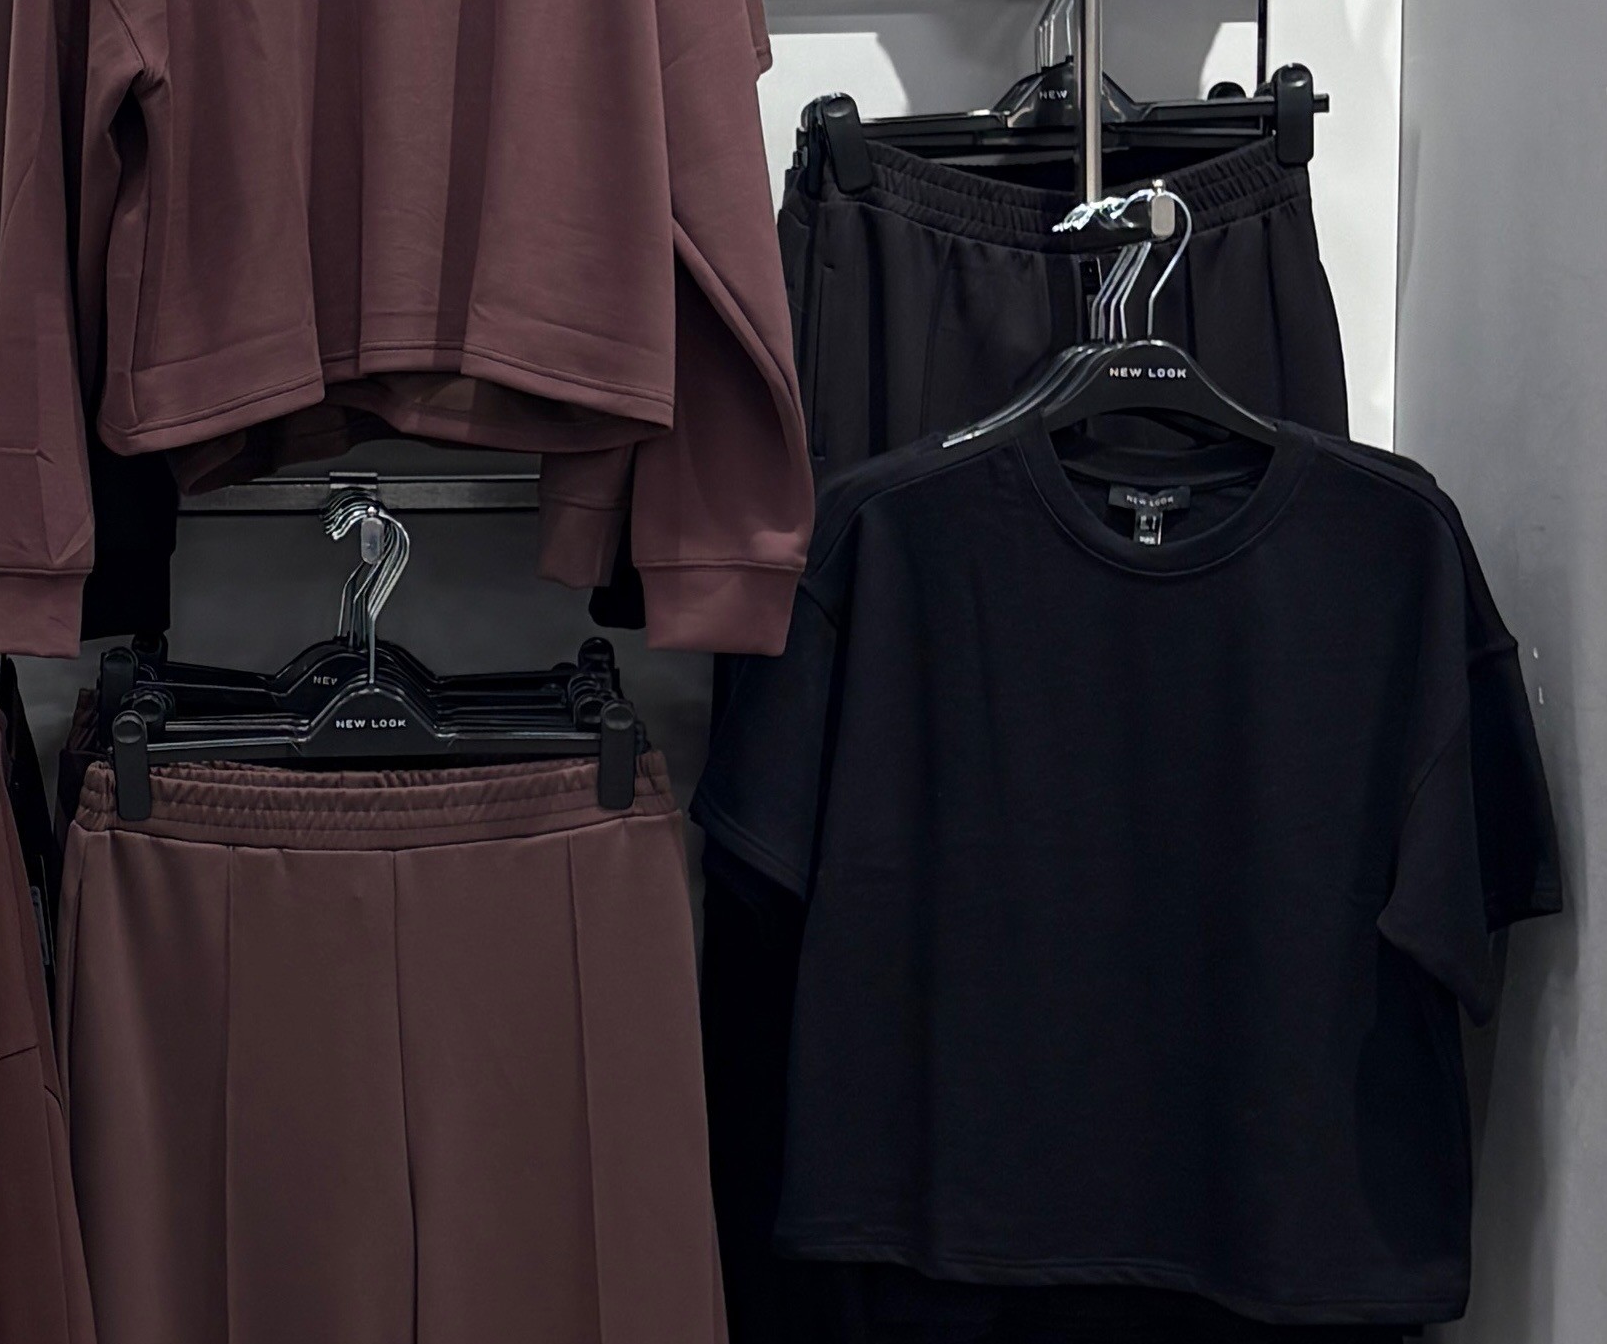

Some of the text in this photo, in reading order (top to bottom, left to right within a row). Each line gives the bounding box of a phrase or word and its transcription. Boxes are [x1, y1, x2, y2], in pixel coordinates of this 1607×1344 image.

[1039, 89, 1068, 100] NEW
[1109, 367, 1187, 378] NEW LOOK
[335, 719, 406, 728] NEW LOOK
